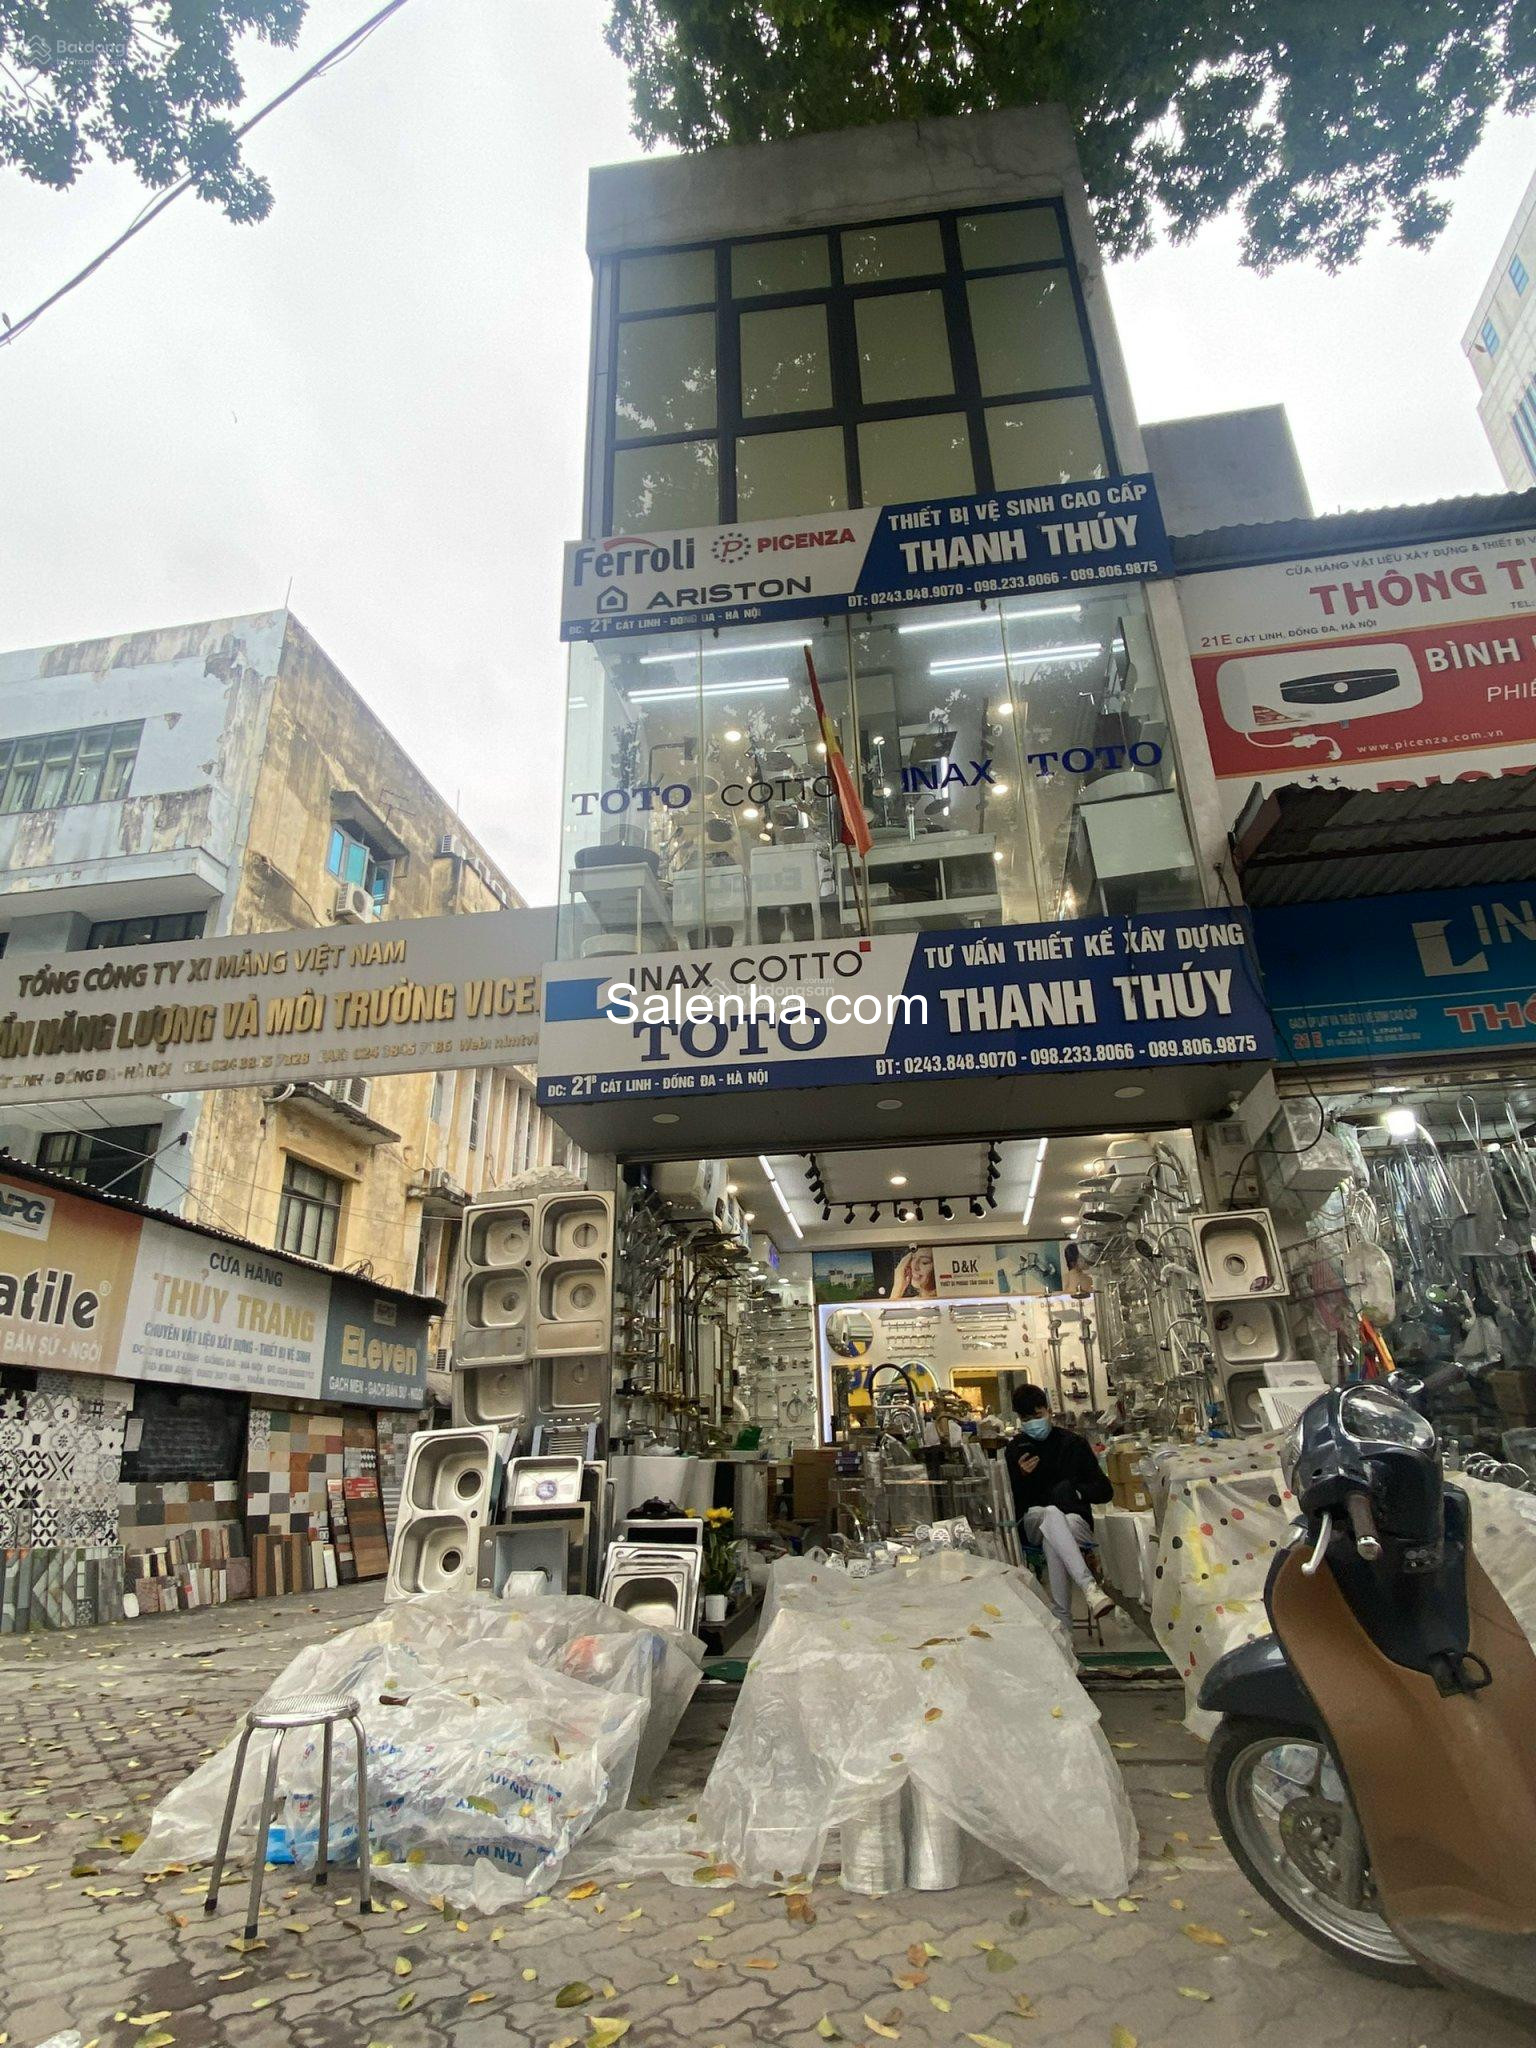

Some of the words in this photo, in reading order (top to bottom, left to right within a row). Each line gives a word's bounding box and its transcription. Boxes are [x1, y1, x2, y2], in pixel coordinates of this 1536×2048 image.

[888, 505, 942, 531] THIẾT
[950, 508, 969, 526] BỊ
[976, 500, 1001, 522] VỆ
[1006, 494, 1055, 518] SINH
[1061, 489, 1101, 508] CAO
[1107, 481, 1148, 503] CẤP
[574, 537, 695, 587] Ferroli
[757, 528, 856, 553] PICENZA
[899, 528, 1028, 574] THANH
[1041, 511, 1140, 556] THÚY
[646, 576, 812, 610] ARISTON
[871, 583, 964, 606] 0243.848.9070
[974, 572, 1060, 593] 098.233.8066
[1070, 560, 1158, 582] 089.806.9875
[1309, 568, 1488, 616] THÔNG
[1201, 633, 1232, 648] 21E
[1425, 638, 1522, 673] BÌNH
[1027, 741, 1163, 778] TOTO
[1356, 728, 1504, 753] www.picenza.com.vn
[572, 784, 692, 816] TOTO
[19, 963, 80, 997] TỔNG
[83, 962, 148, 991] CÔNG
[153, 960, 184, 985] TY
[187, 957, 211, 982] XI
[294, 943, 345, 976] VIỆT
[350, 938, 407, 967] NAM
[924, 944, 956, 969] TƯ
[961, 936, 1006, 966] VẤN
[1013, 931, 1074, 963] THIẾT
[1085, 925, 1116, 957] KẾ
[1125, 927, 1166, 954] XÂY
[1176, 923, 1245, 953] DỰNG
[630, 962, 713, 993] INAX
[730, 950, 863, 984] COTTO
[33, 1010, 117, 1056] NĂNG
[117, 1004, 217, 1054] LƯỢNG
[223, 994, 259, 1038] VÀ
[265, 987, 327, 1036] MÔI
[334, 977, 456, 1030] TRƯỜNG
[464, 976, 542, 1020] VICE
[940, 978, 1097, 1033] THANH
[1112, 962, 1233, 1022] THÚY
[633, 1007, 828, 1062] TOTO
[876, 1059, 901, 1076] ĐT:
[904, 1050, 1017, 1075] 0243.848.9070
[1030, 1043, 1135, 1067] 098.233.8066
[1148, 1035, 1257, 1059] 089.806.9875
[548, 1085, 566, 1097] ĐC:
[601, 1077, 622, 1093] CÁT
[626, 1078, 652, 1092] LINH
[663, 1072, 695, 1090] ĐỐNG
[700, 1074, 716, 1088] ĐA
[726, 1069, 743, 1085] HÀ
[748, 1069, 769, 1086] NỘI
[209, 1250, 240, 1276] CỬA
[244, 1265, 283, 1288] HÀNG
[951, 1259, 979, 1273] D&K
[153, 1268, 230, 1324] THỦY
[236, 1292, 316, 1343] TRANG
